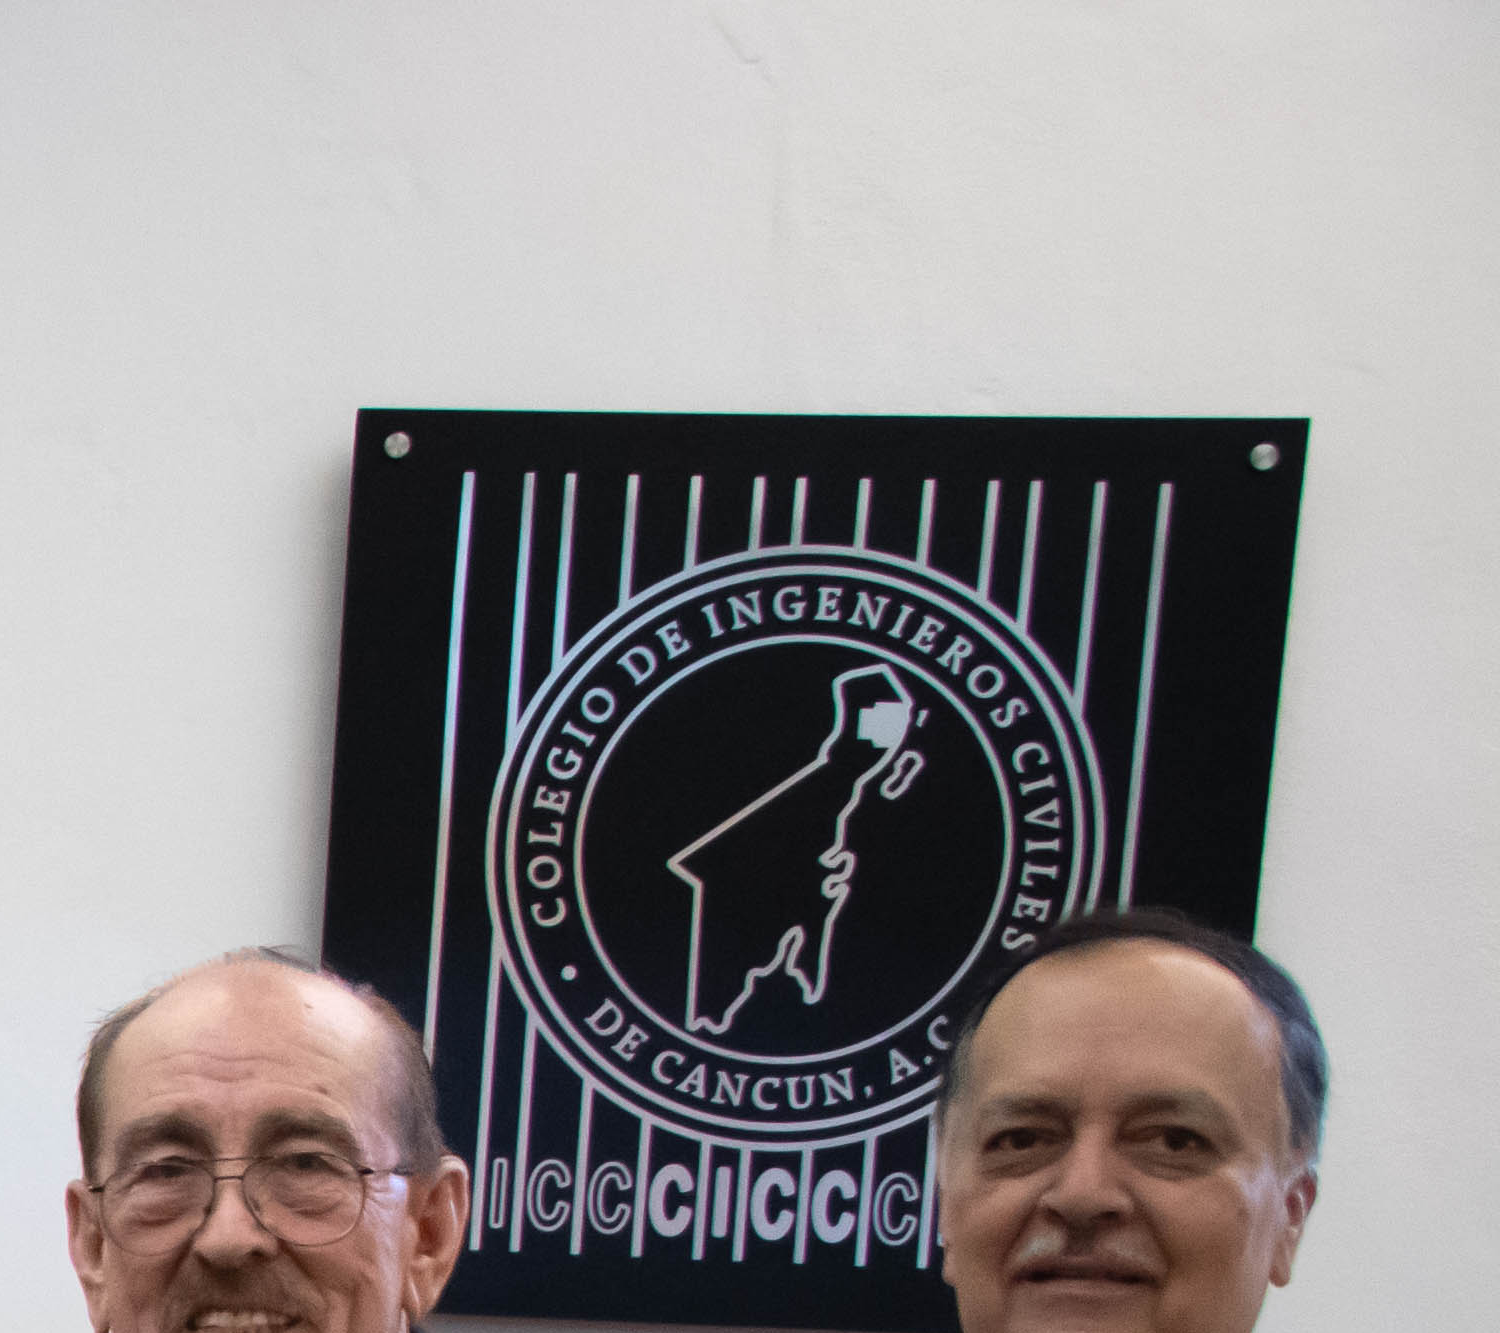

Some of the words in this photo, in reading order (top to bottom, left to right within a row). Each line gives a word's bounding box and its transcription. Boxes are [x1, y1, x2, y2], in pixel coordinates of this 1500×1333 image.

[528, 685, 617, 928] COLEGIO
[617, 619, 693, 687] DE
[701, 586, 1028, 729] INGENIEROS
[1001, 741, 1061, 955] CIVILES
[584, 998, 649, 1062] DE
[651, 1050, 875, 1112] CANCUN,
